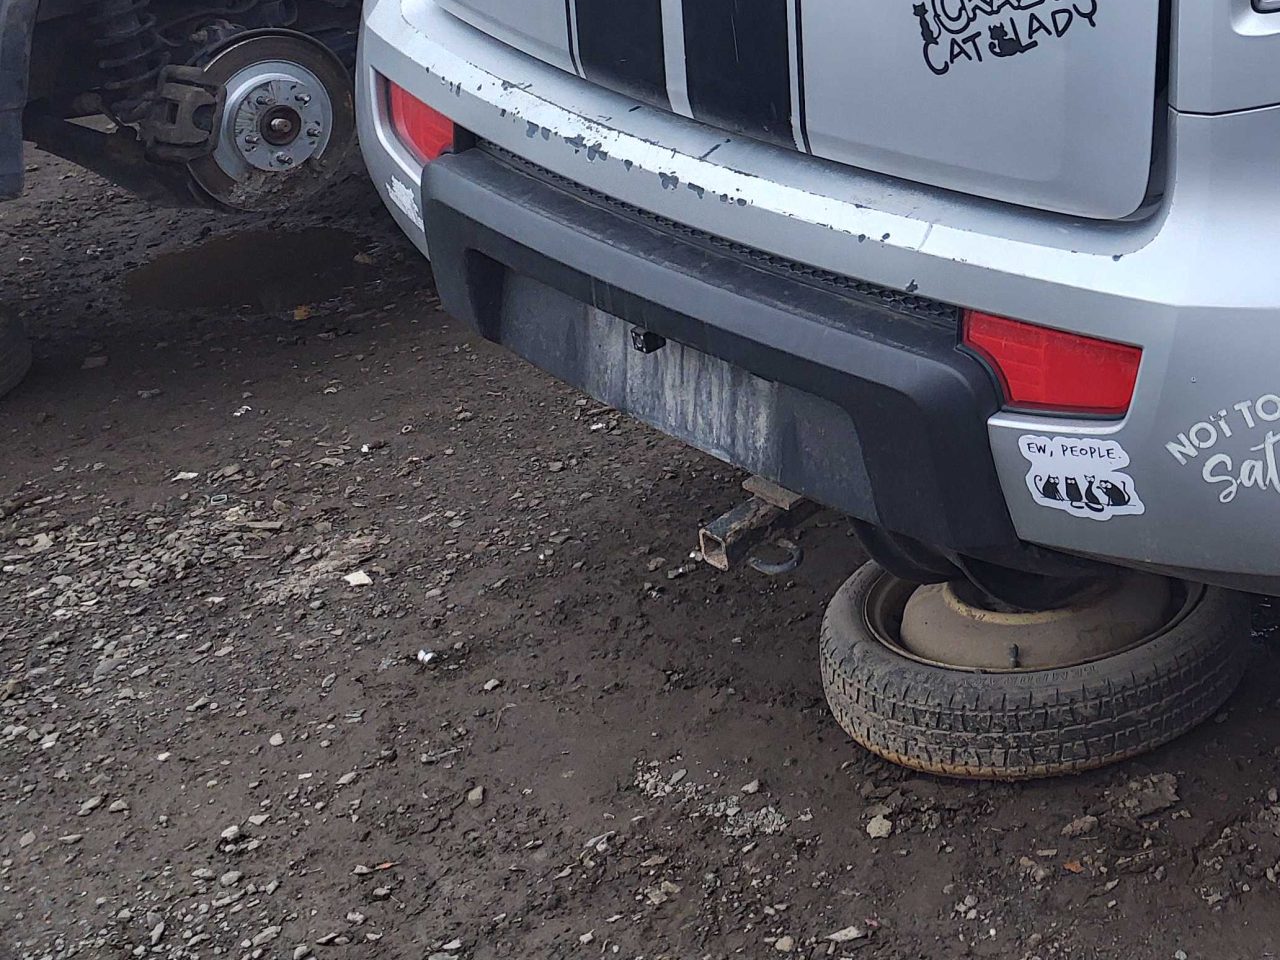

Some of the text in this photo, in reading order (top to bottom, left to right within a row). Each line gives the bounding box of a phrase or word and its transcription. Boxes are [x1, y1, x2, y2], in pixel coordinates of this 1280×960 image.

[922, 31, 983, 76] CAT
[1026, 441, 1122, 460] EW, PEOPLE.
[1164, 408, 1233, 466] NOT
